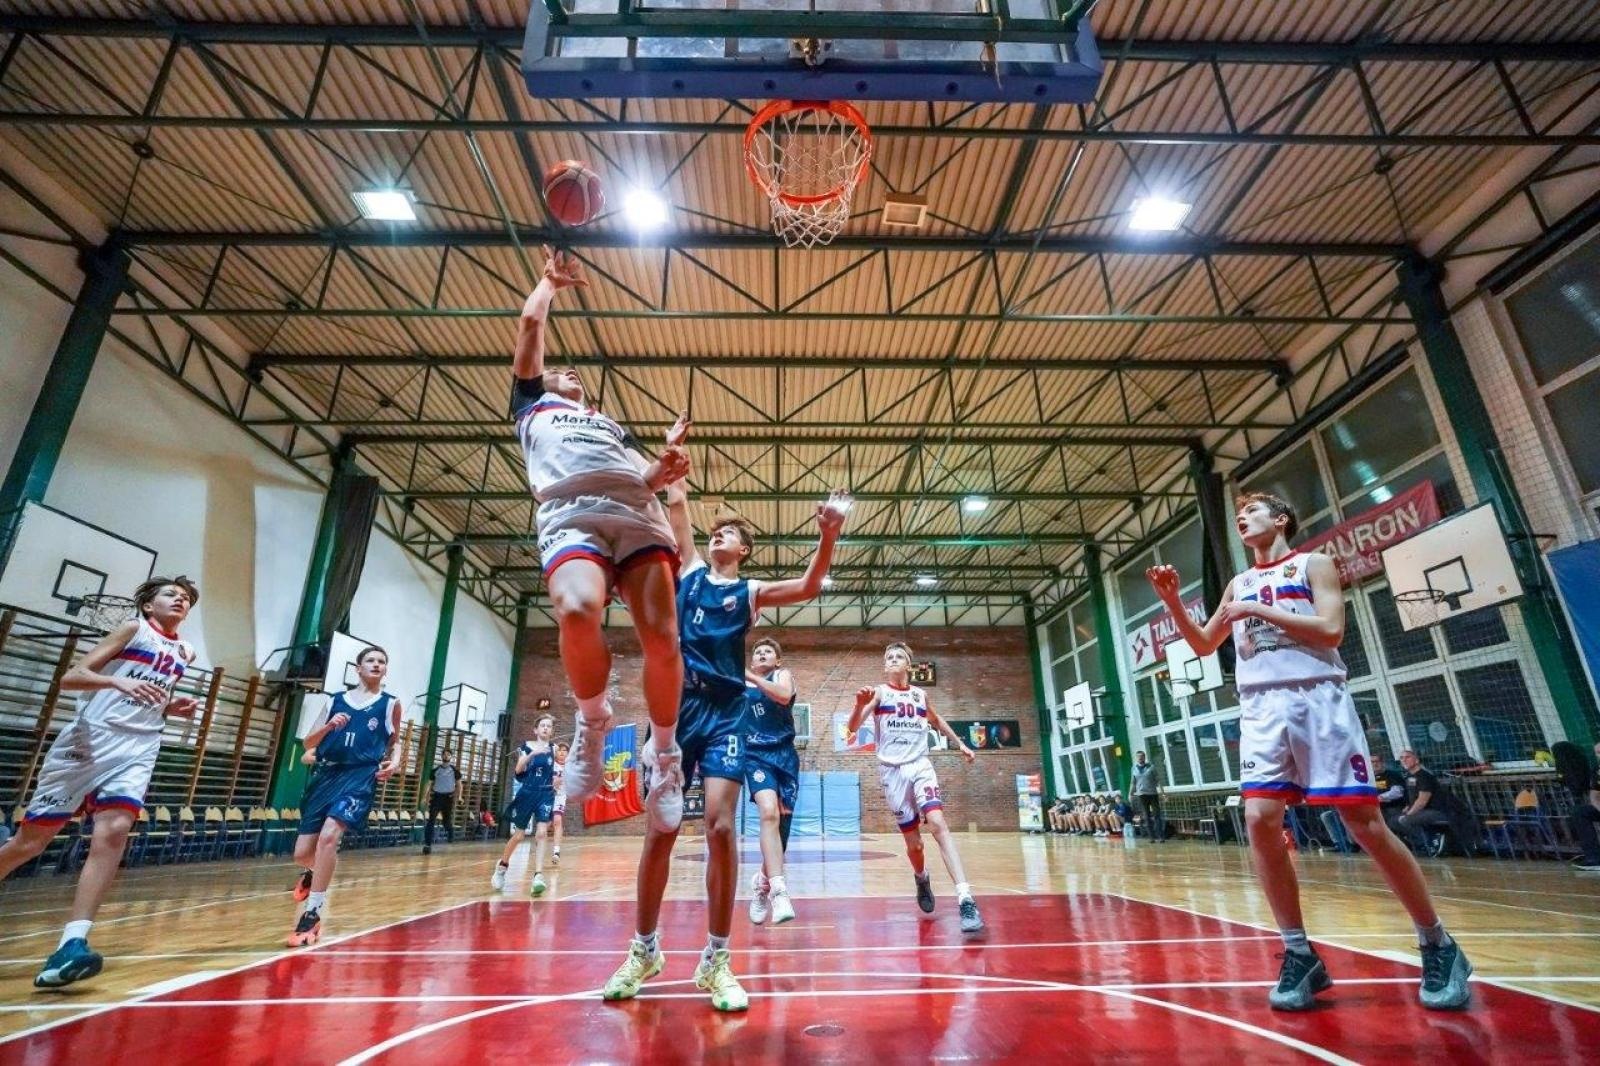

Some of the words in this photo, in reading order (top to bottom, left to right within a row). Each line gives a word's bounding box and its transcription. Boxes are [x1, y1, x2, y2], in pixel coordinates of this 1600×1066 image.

[1259, 584, 1274, 607] 9
[692, 606, 704, 625] 8
[1151, 602, 1207, 642] TAUN
[153, 651, 175, 676] 12
[751, 703, 765, 719] 16
[896, 702, 915, 718] 30
[344, 731, 356, 748] 11
[727, 735, 738, 757] 8
[1350, 754, 1369, 784] 9
